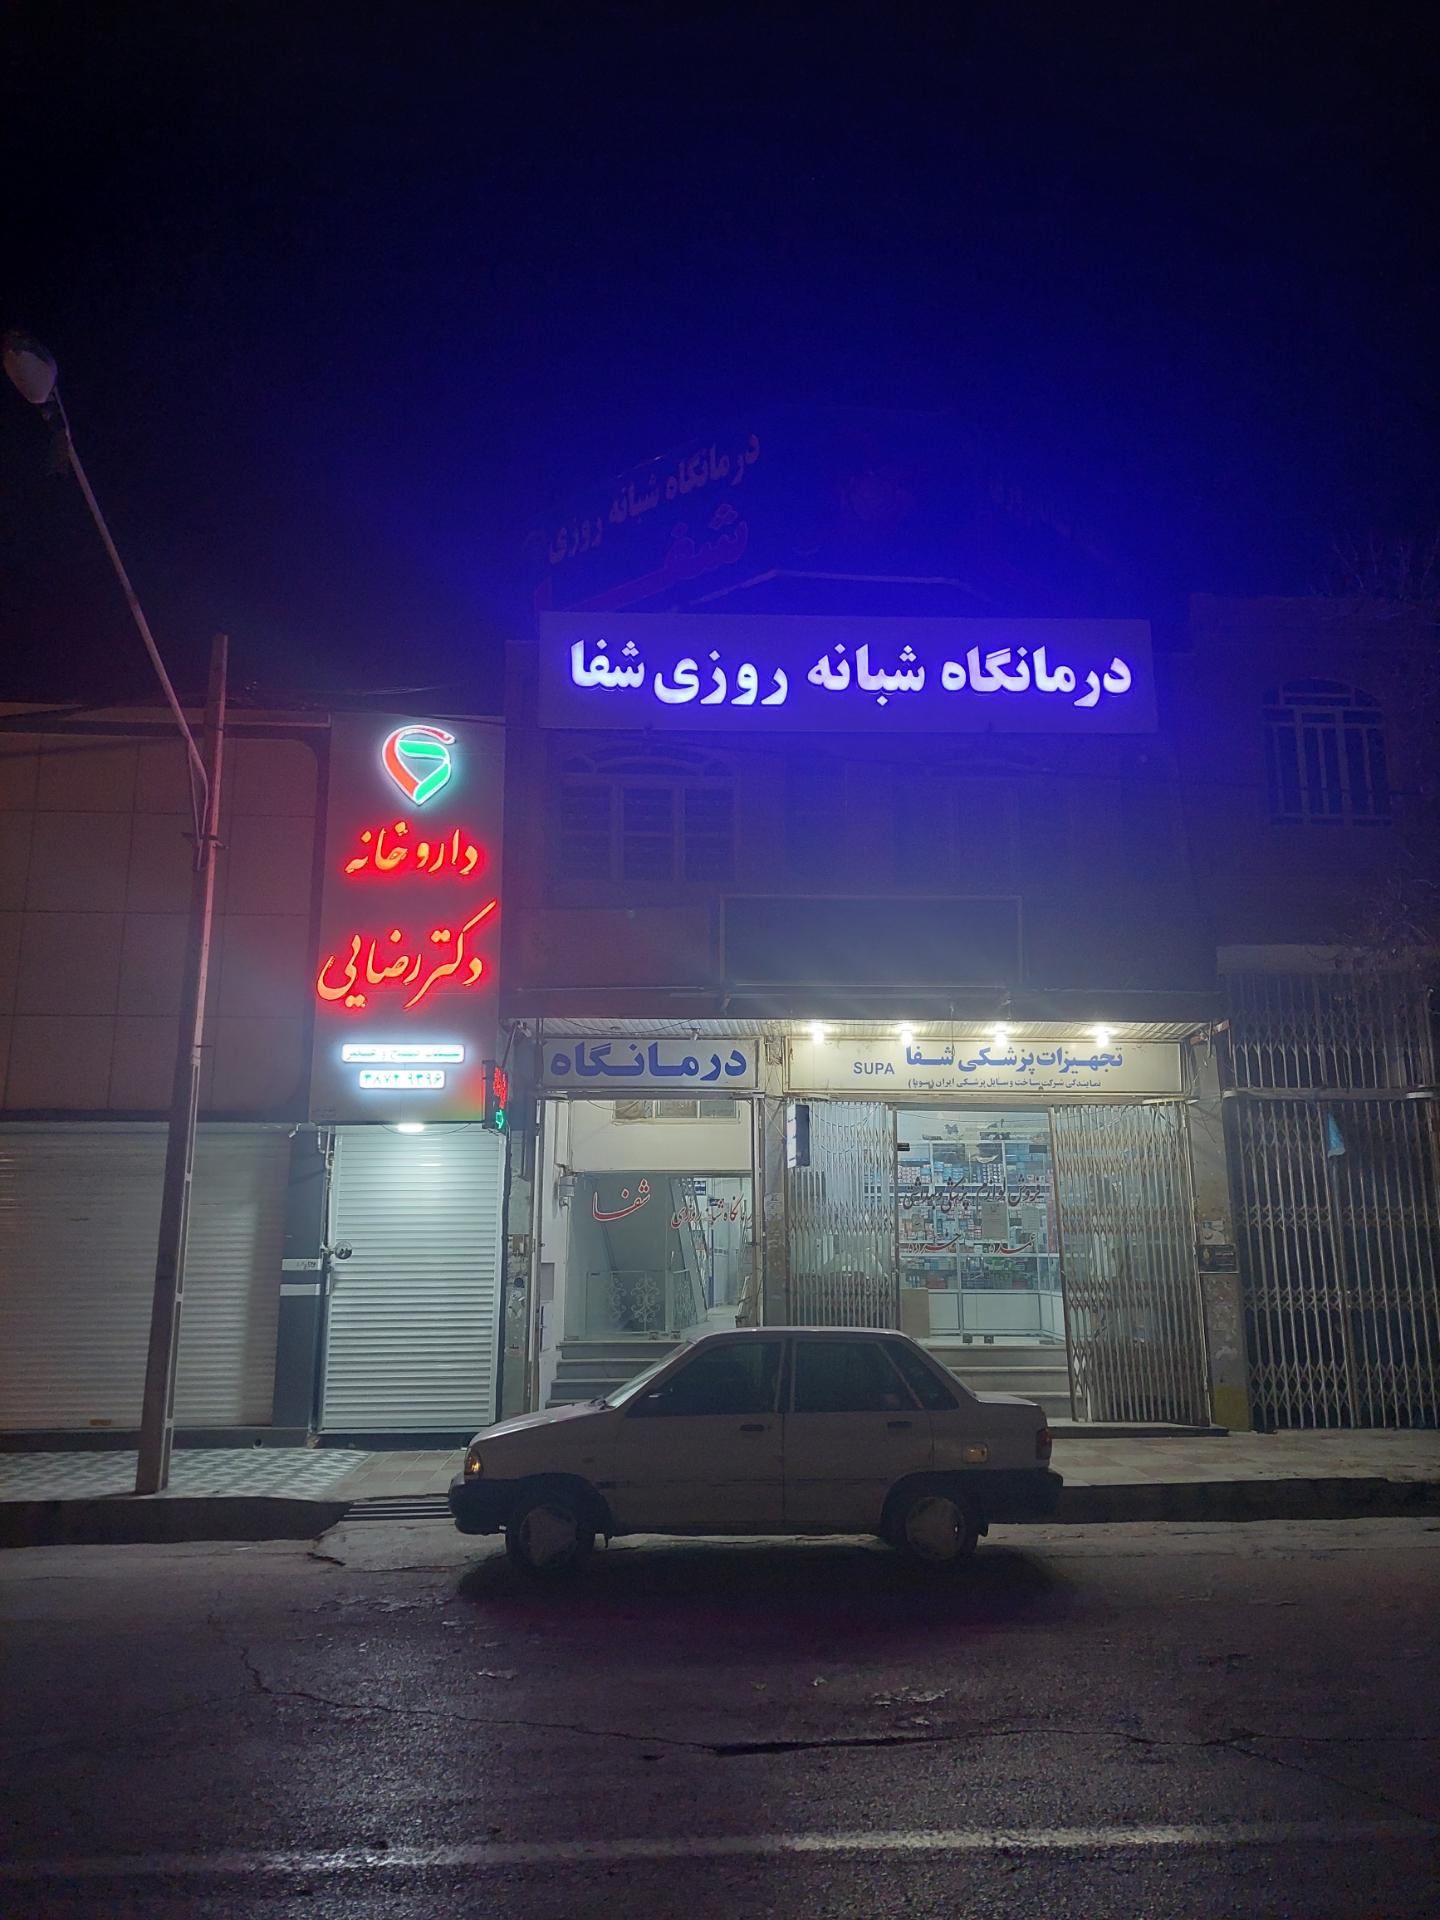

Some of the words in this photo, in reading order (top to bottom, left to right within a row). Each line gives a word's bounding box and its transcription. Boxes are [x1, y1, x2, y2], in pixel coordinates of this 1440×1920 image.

[569, 638, 647, 692] شفا
[652, 649, 790, 706] روزی
[806, 643, 926, 707] شبانه
[940, 644, 1133, 708] درمانگاه
[317, 929, 422, 1008] رضایی
[403, 899, 497, 1008] دکتر
[550, 1041, 748, 1082] درمانگاه
[852, 1061, 896, 1075] SUPA
[905, 1045, 955, 1067] شفا
[957, 1046, 1034, 1075] پزشکی
[1036, 1046, 1124, 1074] تجهیزات
[935, 1077, 955, 1088] ایران
[592, 1178, 650, 1221] شفا
[1008, 1173, 1041, 1208] فروش
